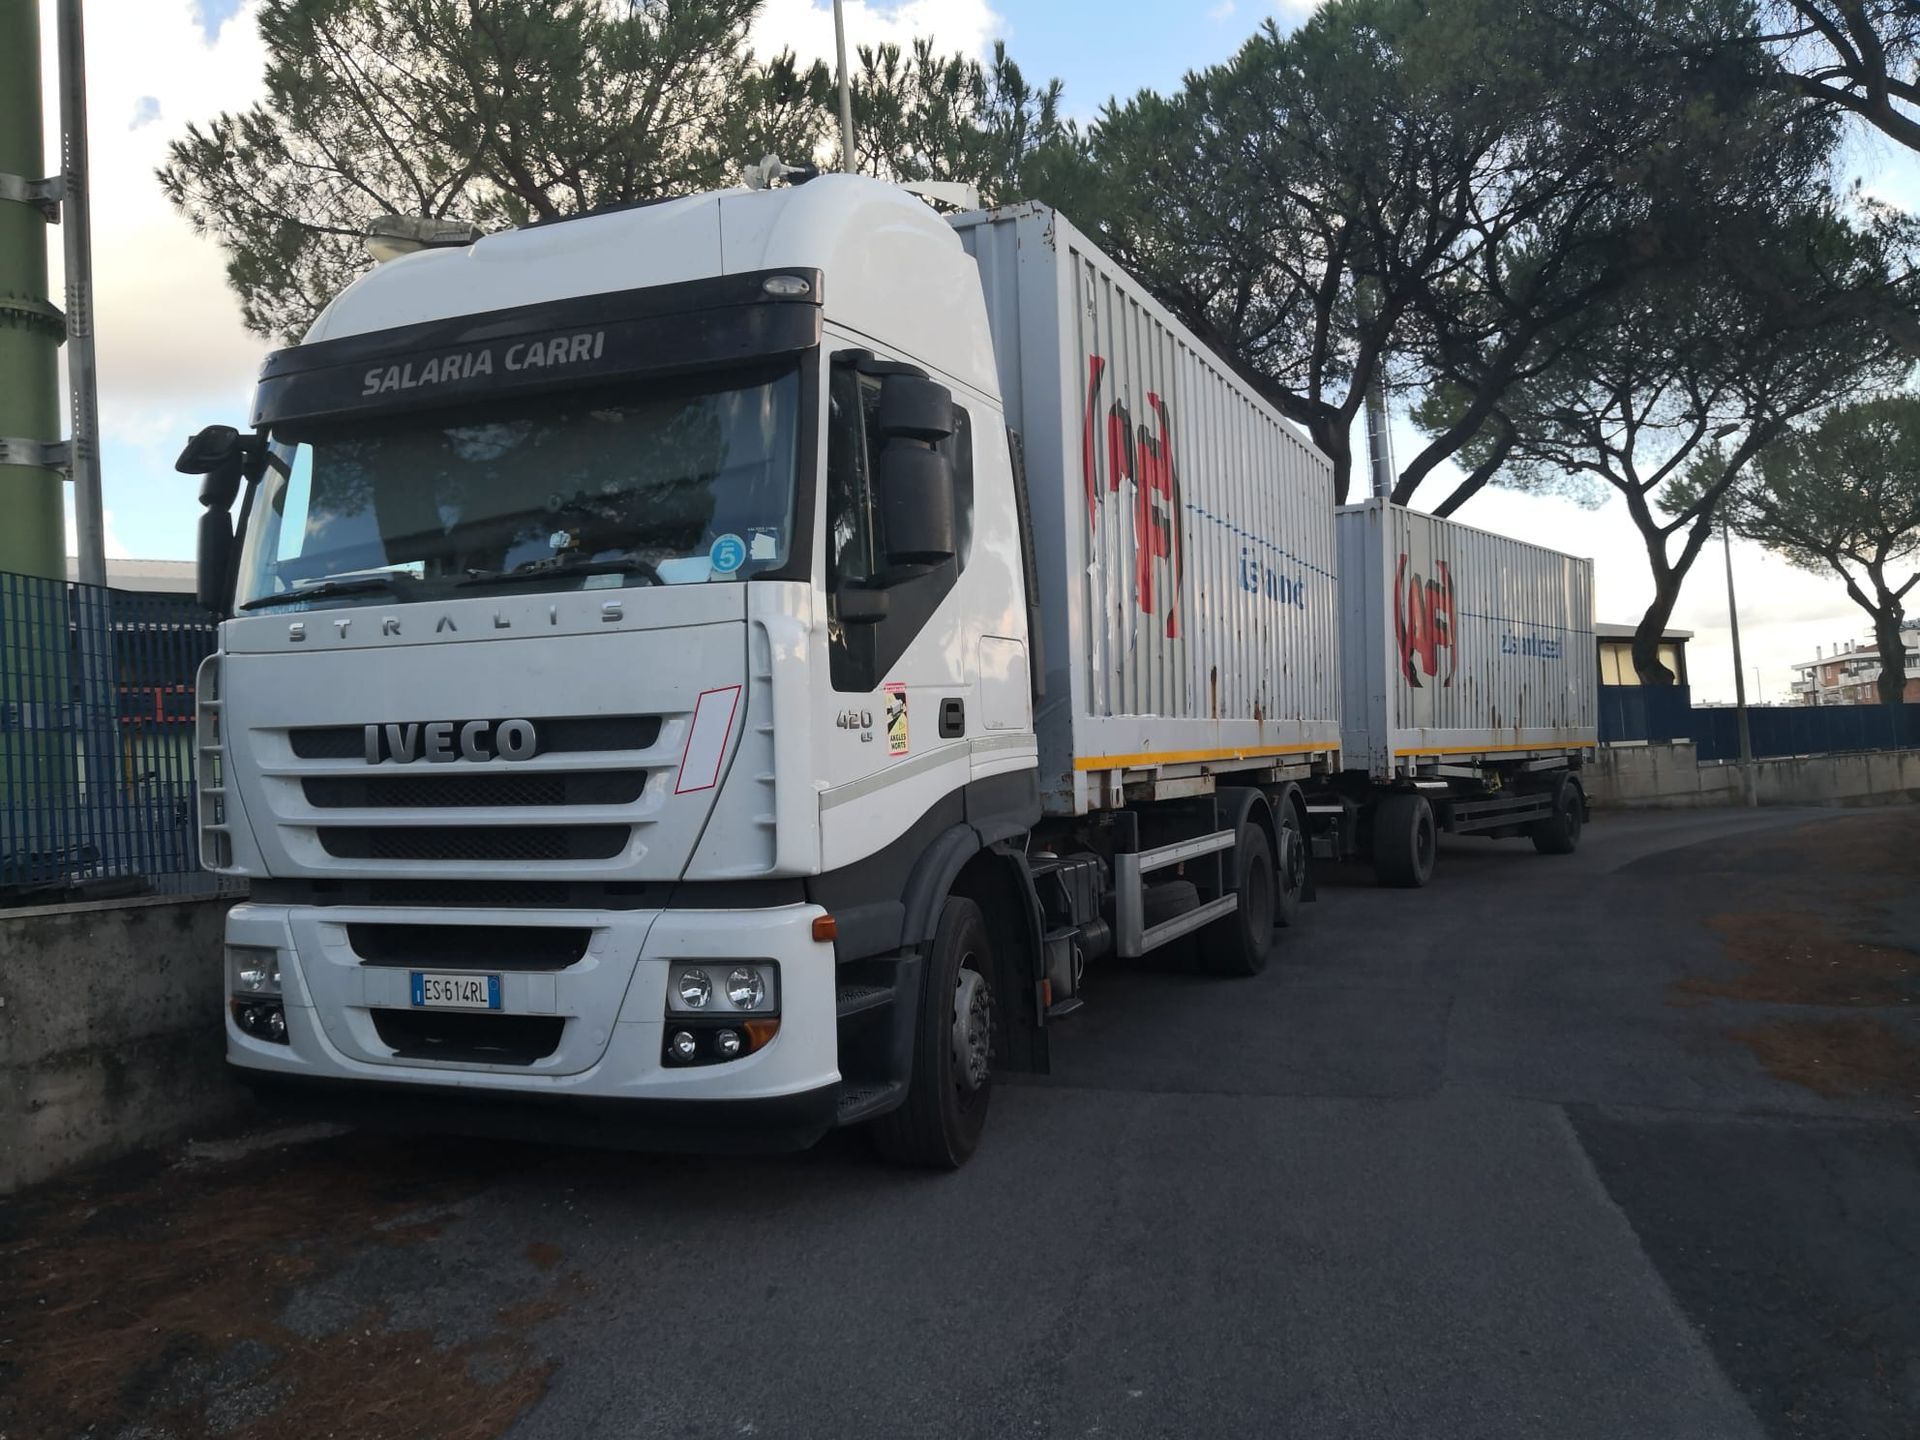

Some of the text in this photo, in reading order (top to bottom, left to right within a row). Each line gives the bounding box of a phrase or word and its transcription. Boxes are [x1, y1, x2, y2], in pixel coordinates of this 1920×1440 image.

[361, 331, 606, 396] SALARIA CARRI
[719, 546, 737, 568] 5
[289, 601, 624, 642] STRALIS
[836, 709, 873, 730] 420
[364, 719, 537, 765] IVECO
